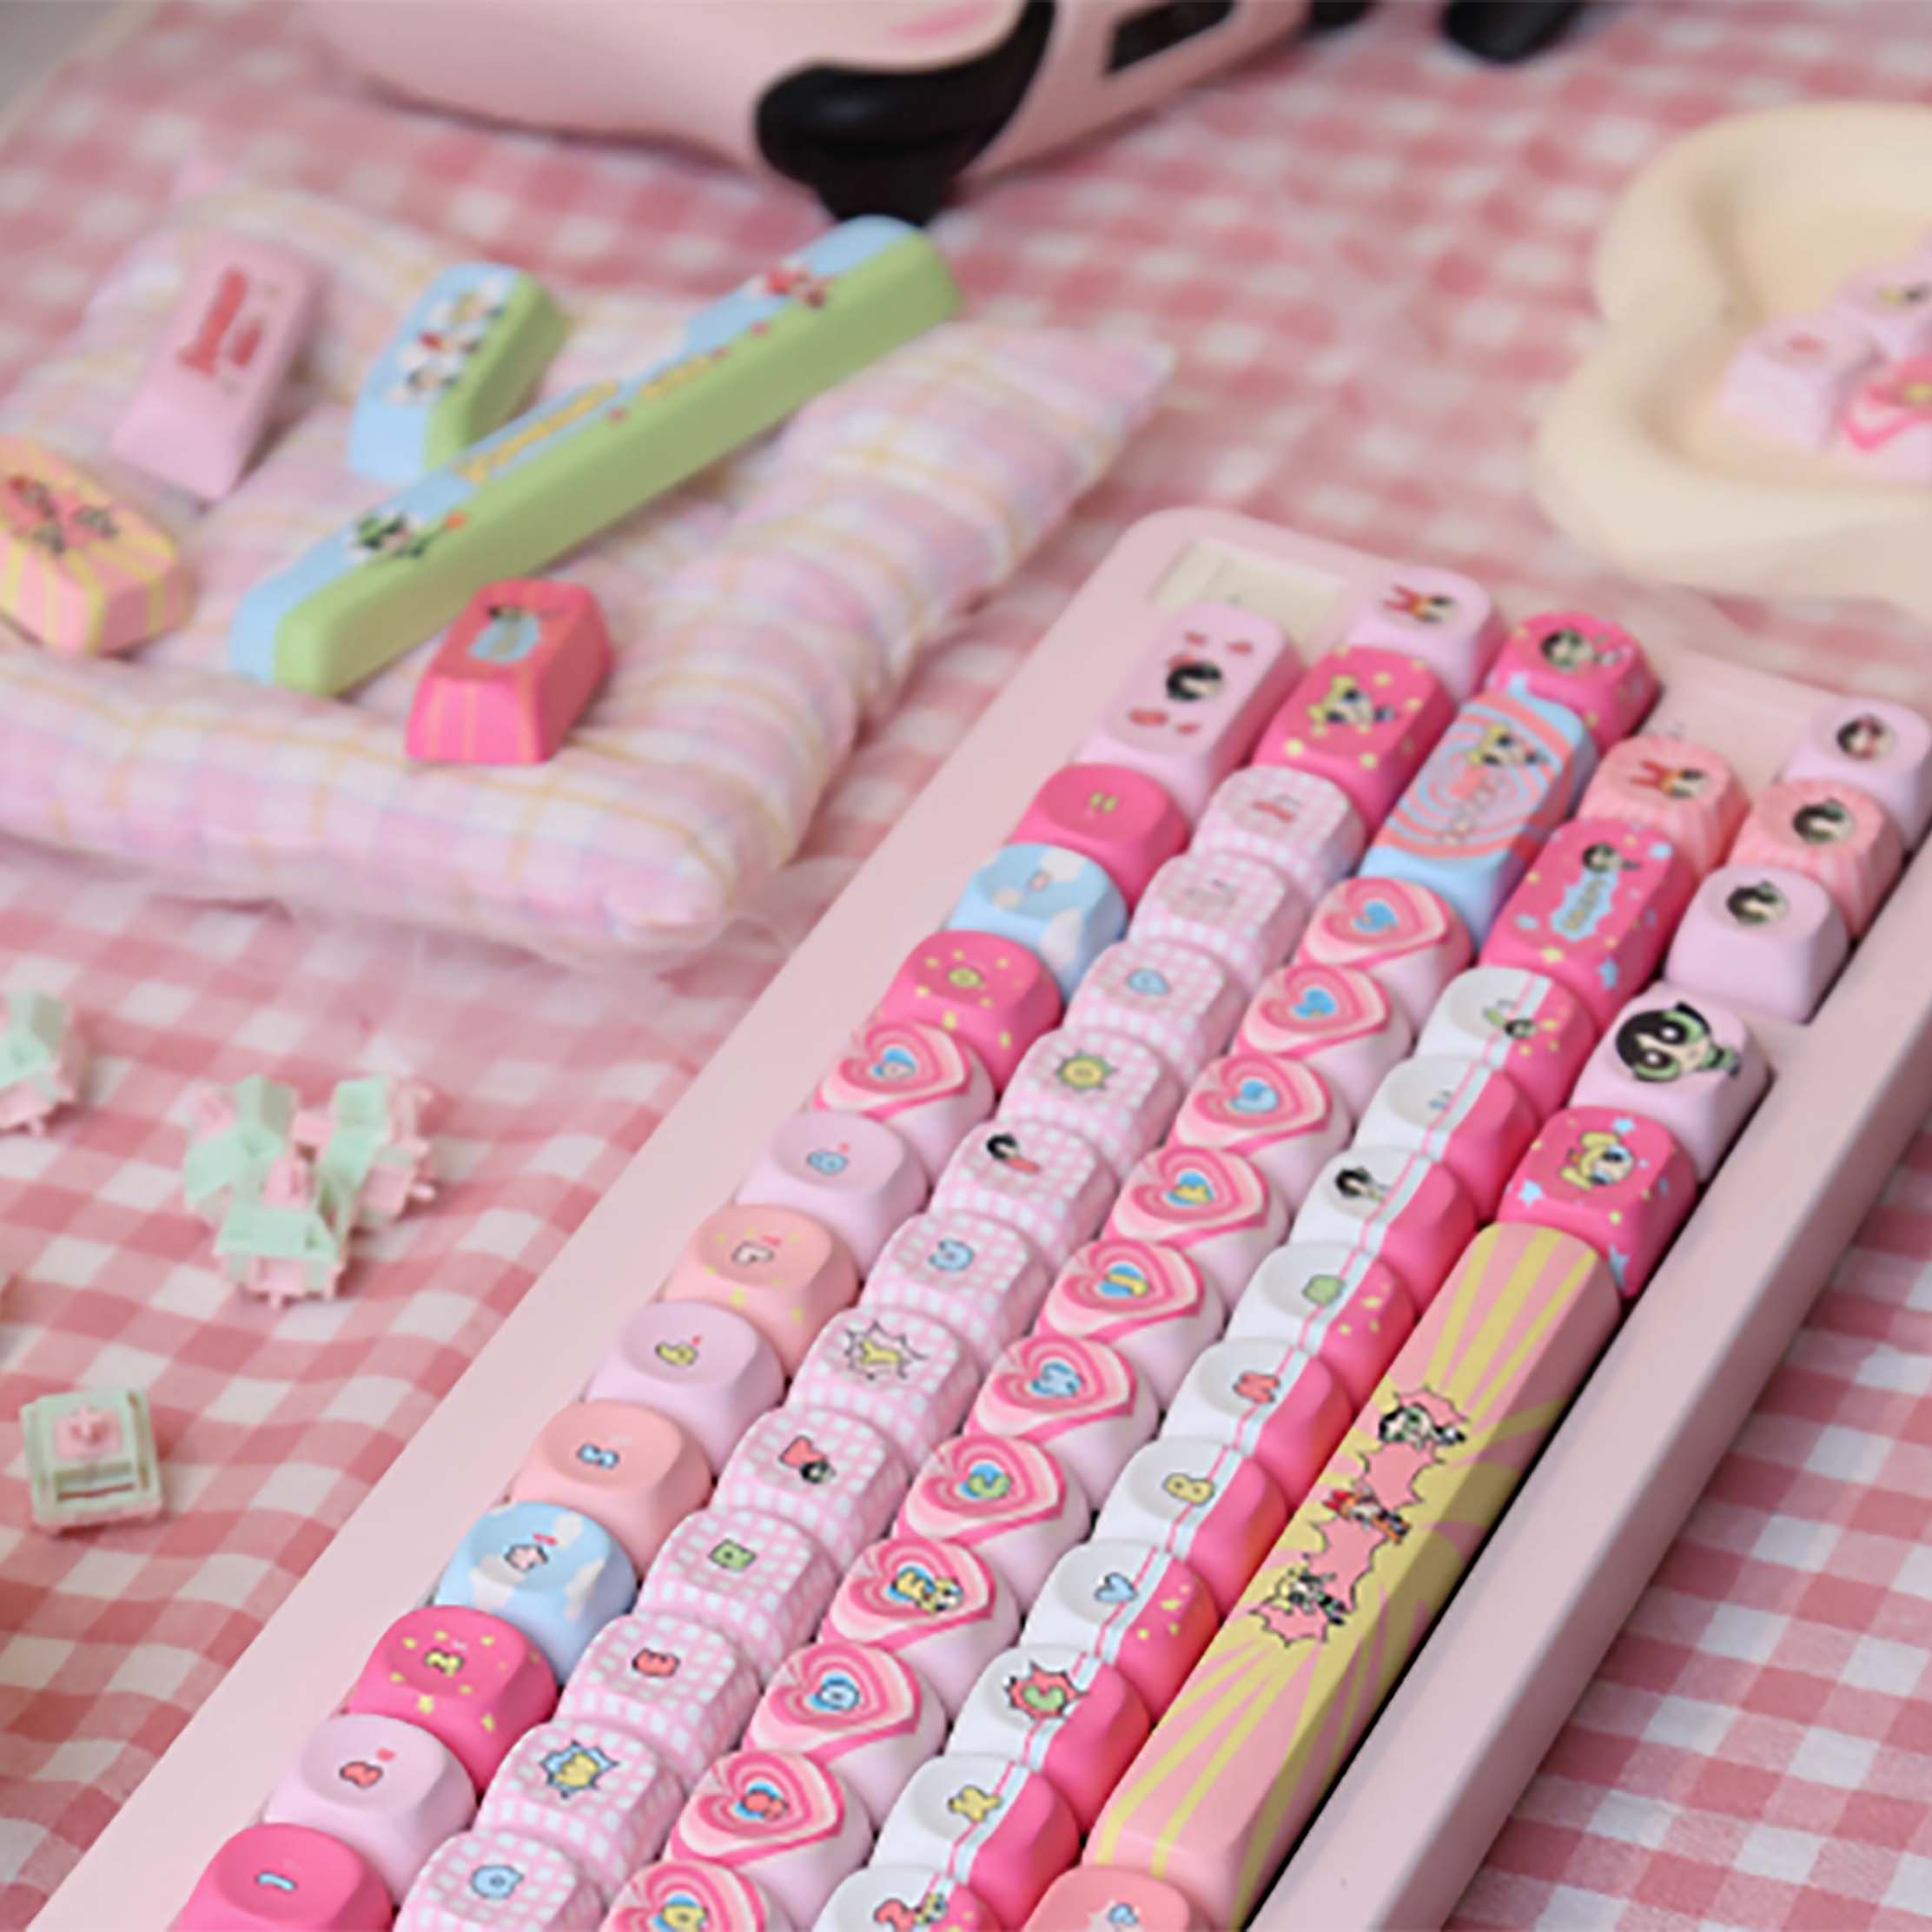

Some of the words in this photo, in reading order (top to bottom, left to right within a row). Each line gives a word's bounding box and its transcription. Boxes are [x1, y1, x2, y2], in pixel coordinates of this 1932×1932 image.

[930, 1239, 974, 1272] U
[1233, 1372, 1280, 1404] N
[577, 1443, 619, 1469] 5
[1163, 1473, 1214, 1505] B
[709, 1539, 756, 1571] R
[1095, 1573, 1137, 1602] V
[424, 1648, 464, 1677] 3
[632, 1648, 680, 1677] E
[817, 1681, 860, 1711] D
[1022, 1684, 1065, 1710] C
[949, 1785, 1002, 1822] X
[255, 1870, 296, 1891] 1
[470, 1864, 523, 1900] Q
